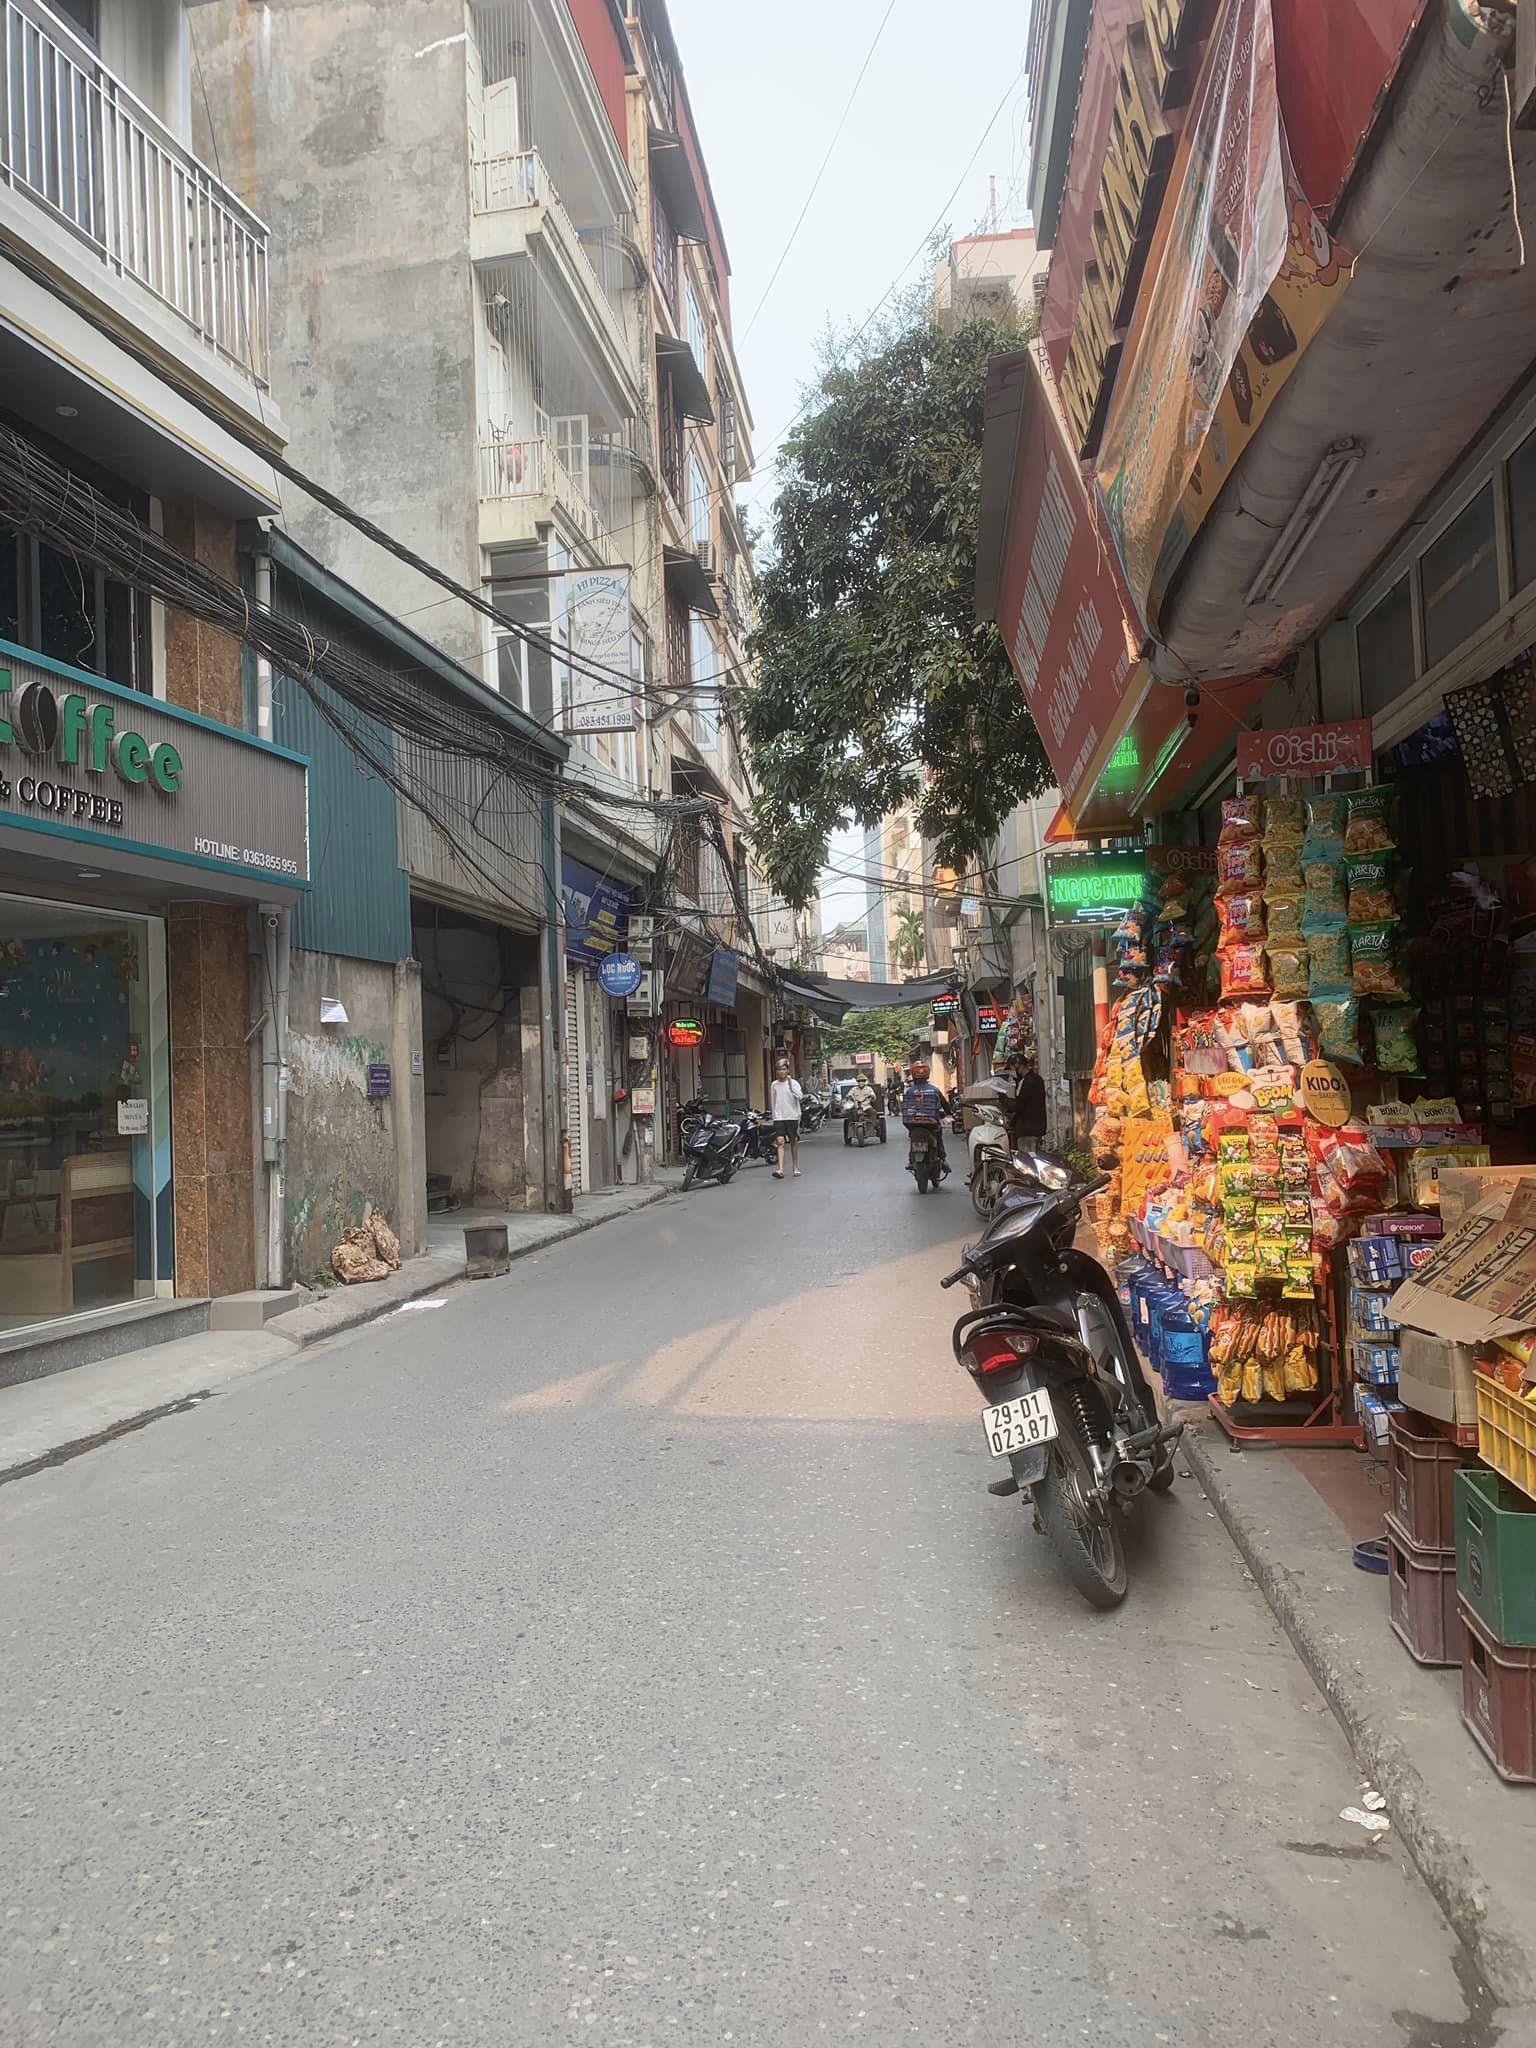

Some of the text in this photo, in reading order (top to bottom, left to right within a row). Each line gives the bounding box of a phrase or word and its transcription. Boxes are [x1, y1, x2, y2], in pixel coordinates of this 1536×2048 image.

[1031, 450, 1077, 617] MINIMART
[1268, 732, 1338, 767] Oishi
[17, 776, 123, 826] COFFEE
[1053, 876, 1103, 907] NGỌC
[1455, 1231, 1515, 1287] wake-up
[992, 1394, 1040, 1429] 29-D1
[992, 1414, 1048, 1453] 023.87
